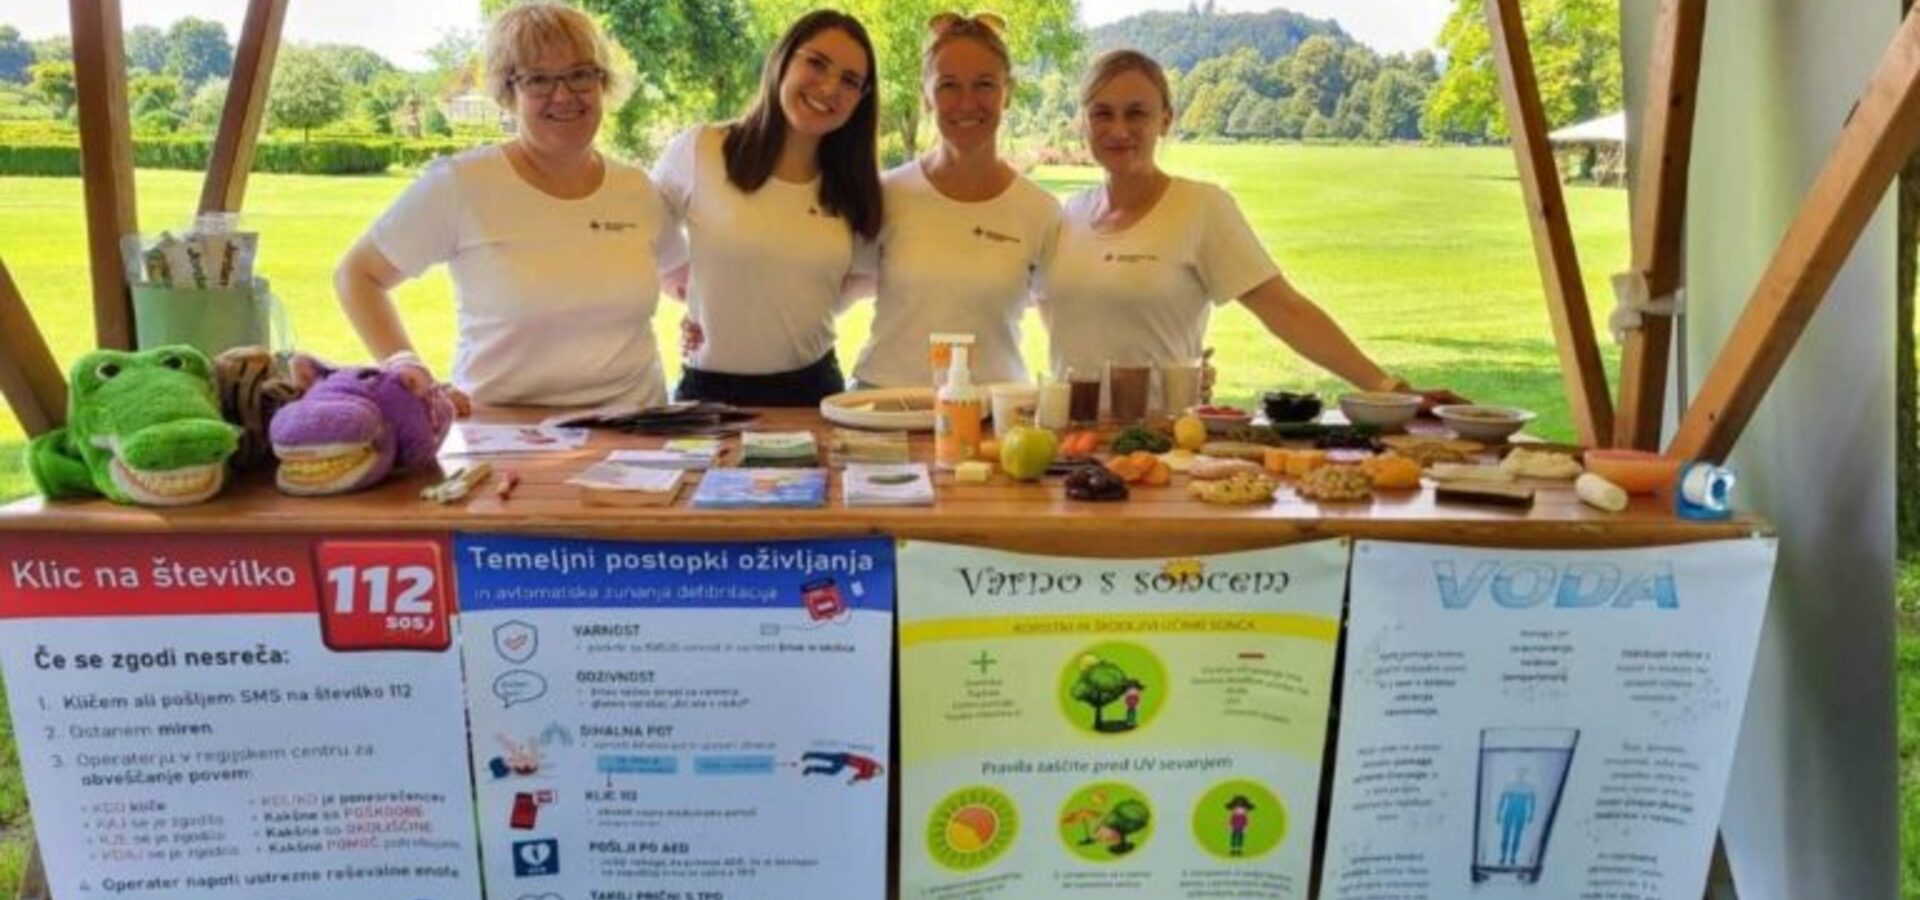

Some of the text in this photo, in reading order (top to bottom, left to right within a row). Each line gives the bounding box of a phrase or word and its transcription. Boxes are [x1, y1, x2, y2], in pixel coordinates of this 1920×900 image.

[467, 546, 874, 575] Temeljni postopki oživljanja
[11, 557, 297, 589] Klic na številko
[955, 566, 1290, 598] Varno s soncem
[326, 565, 435, 615] 112
[473, 583, 779, 602] in avtomatska zunanja defibrilacija
[1431, 558, 1681, 610] VODA
[573, 624, 641, 638] VARNOST
[34, 644, 290, 672] Če se zgodi nesreča:
[576, 670, 656, 684] ODZIVNOST
[63, 693, 129, 709] Kličem
[134, 693, 156, 709] ali
[161, 689, 234, 710] pošljem
[240, 689, 282, 703] SMS
[286, 690, 309, 702] na
[314, 684, 384, 701] številko
[389, 683, 412, 699] 112
[69, 724, 153, 739] Ostanem
[157, 722, 213, 737] miren
[579, 725, 674, 738] DIHALNA POT
[291, 744, 349, 758] centru
[354, 744, 374, 756] za
[981, 755, 1233, 777] Pravila zaščite pred UV sevanjem
[82, 769, 183, 786] obveščanje
[589, 840, 690, 854] POŠLJI PO AED
[101, 877, 179, 893] Operater
